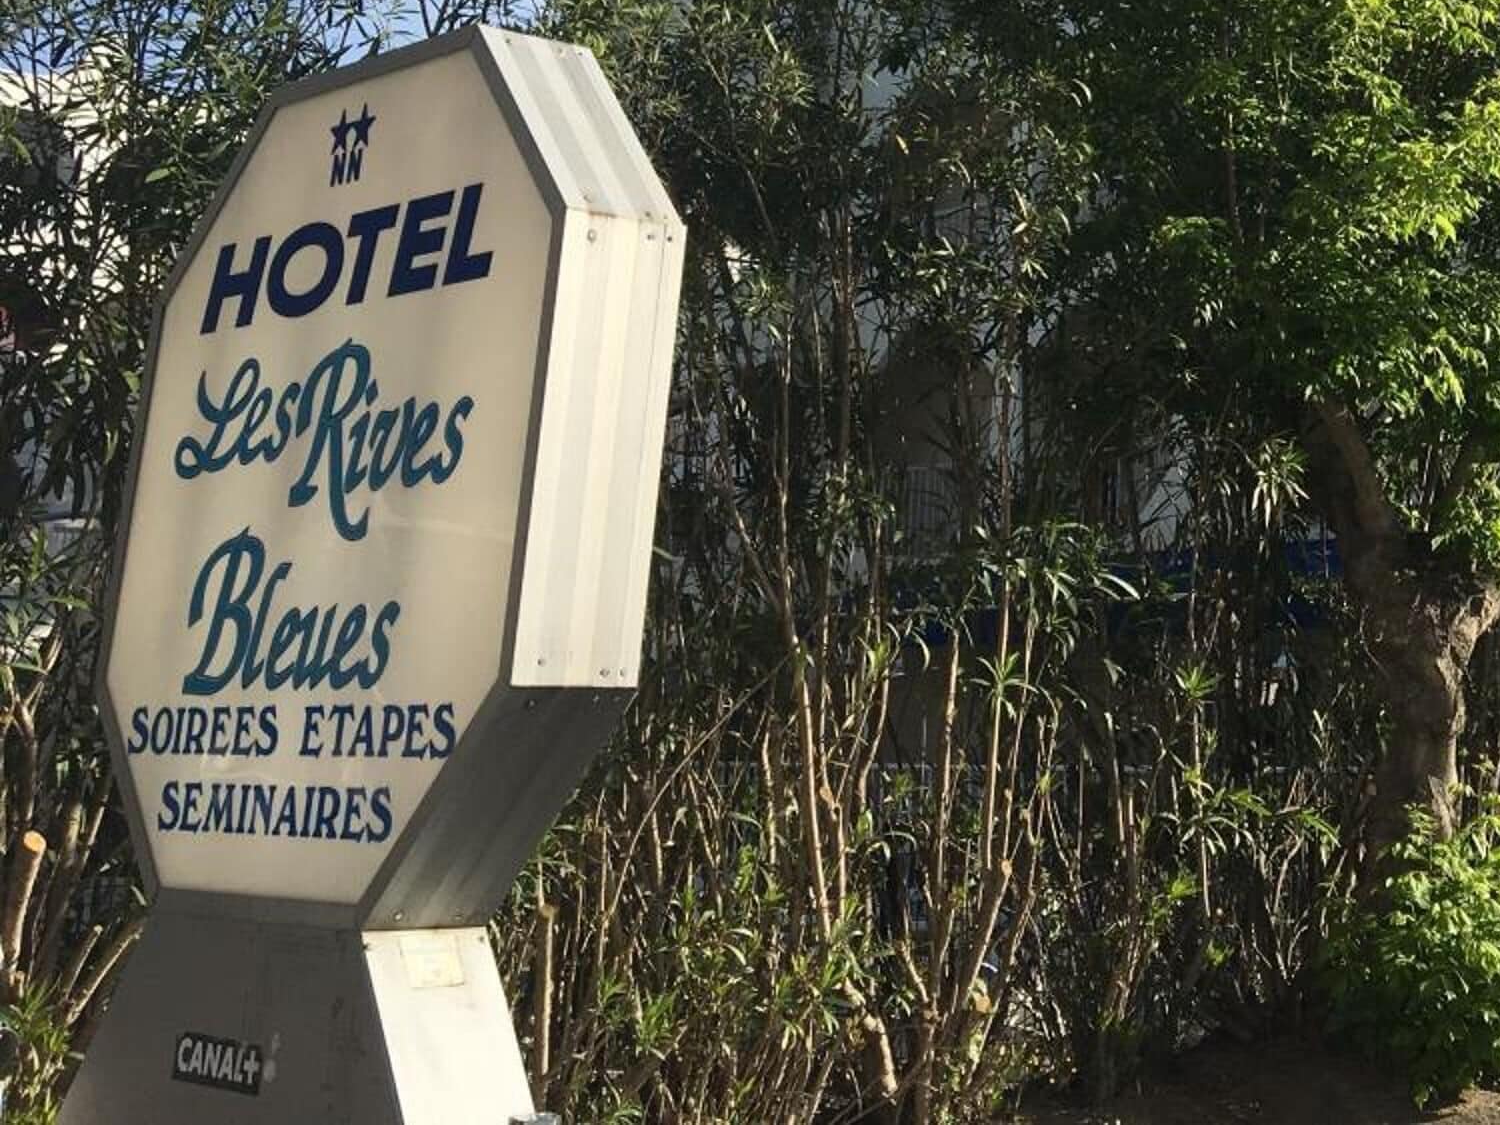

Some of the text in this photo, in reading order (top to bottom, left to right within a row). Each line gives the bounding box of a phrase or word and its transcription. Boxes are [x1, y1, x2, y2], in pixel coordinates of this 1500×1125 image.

[329, 147, 363, 187] NN
[200, 183, 494, 335] HOTEL
[174, 338, 475, 541] Les Rives
[182, 526, 400, 695] Bleues
[128, 703, 456, 759] SOIREES ETAPES
[158, 781, 393, 843] SEMINAIRES
[178, 1037, 260, 1084] CANAL+
